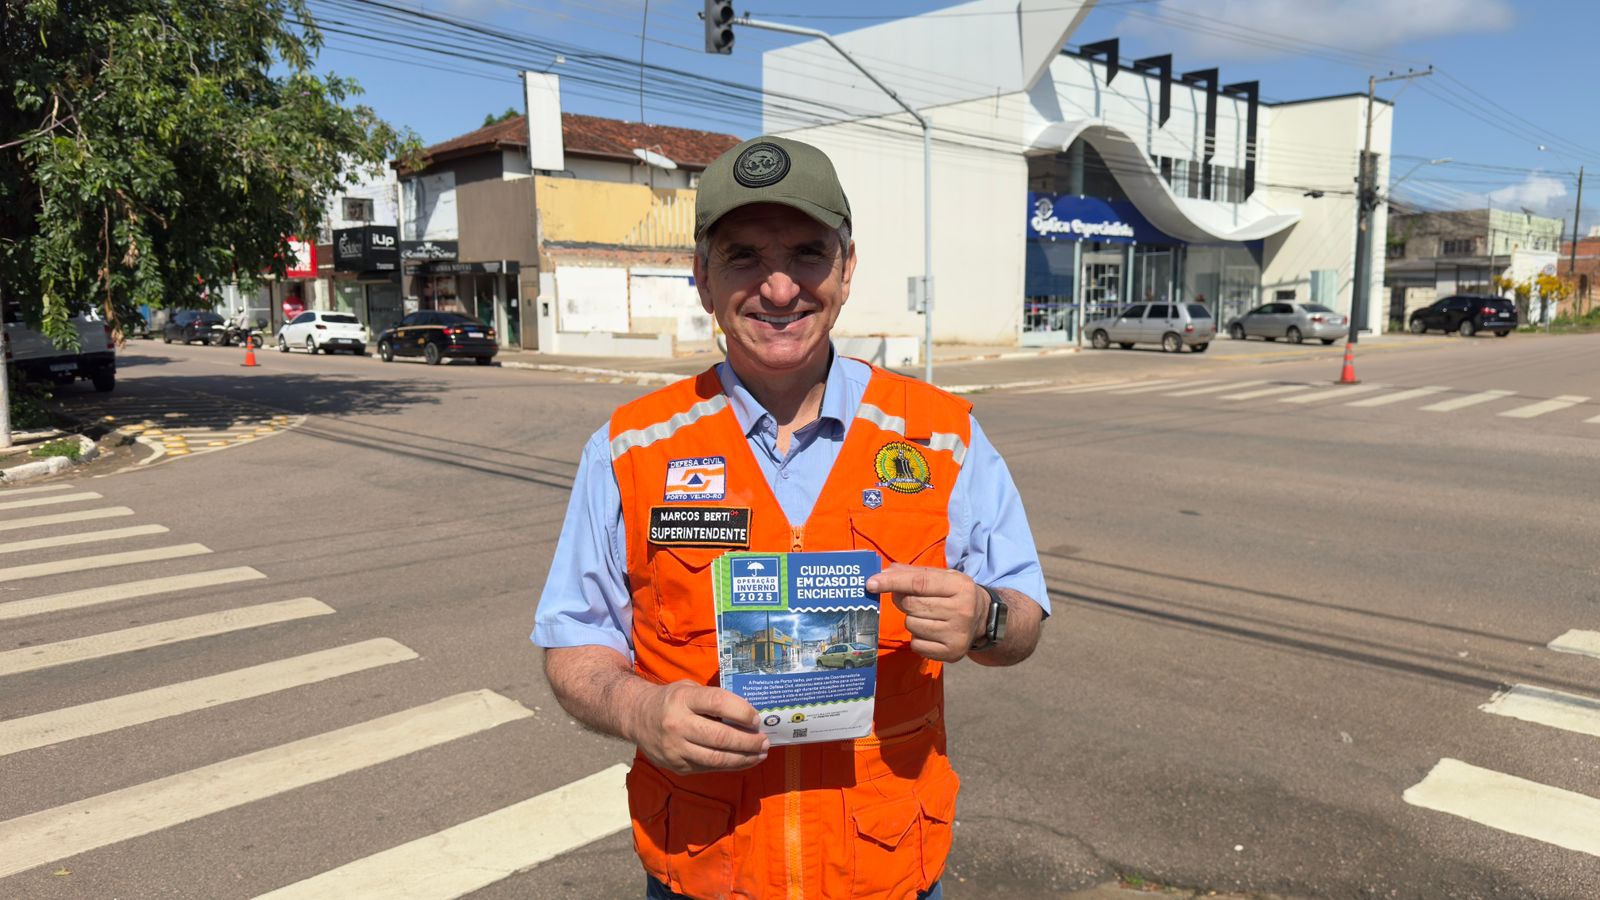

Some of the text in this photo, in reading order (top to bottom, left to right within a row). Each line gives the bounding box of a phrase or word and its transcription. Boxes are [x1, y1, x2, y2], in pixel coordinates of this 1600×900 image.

[670, 460, 699, 468] DEFESA
[660, 512, 700, 521] MARCOS
[704, 512, 730, 521] BERTI
[651, 527, 746, 540] SUPERINTENDENTE
[800, 565, 860, 576] CUIDADOS
[796, 576, 865, 587] EM CASO DE
[798, 588, 865, 599] ENCHENTES
